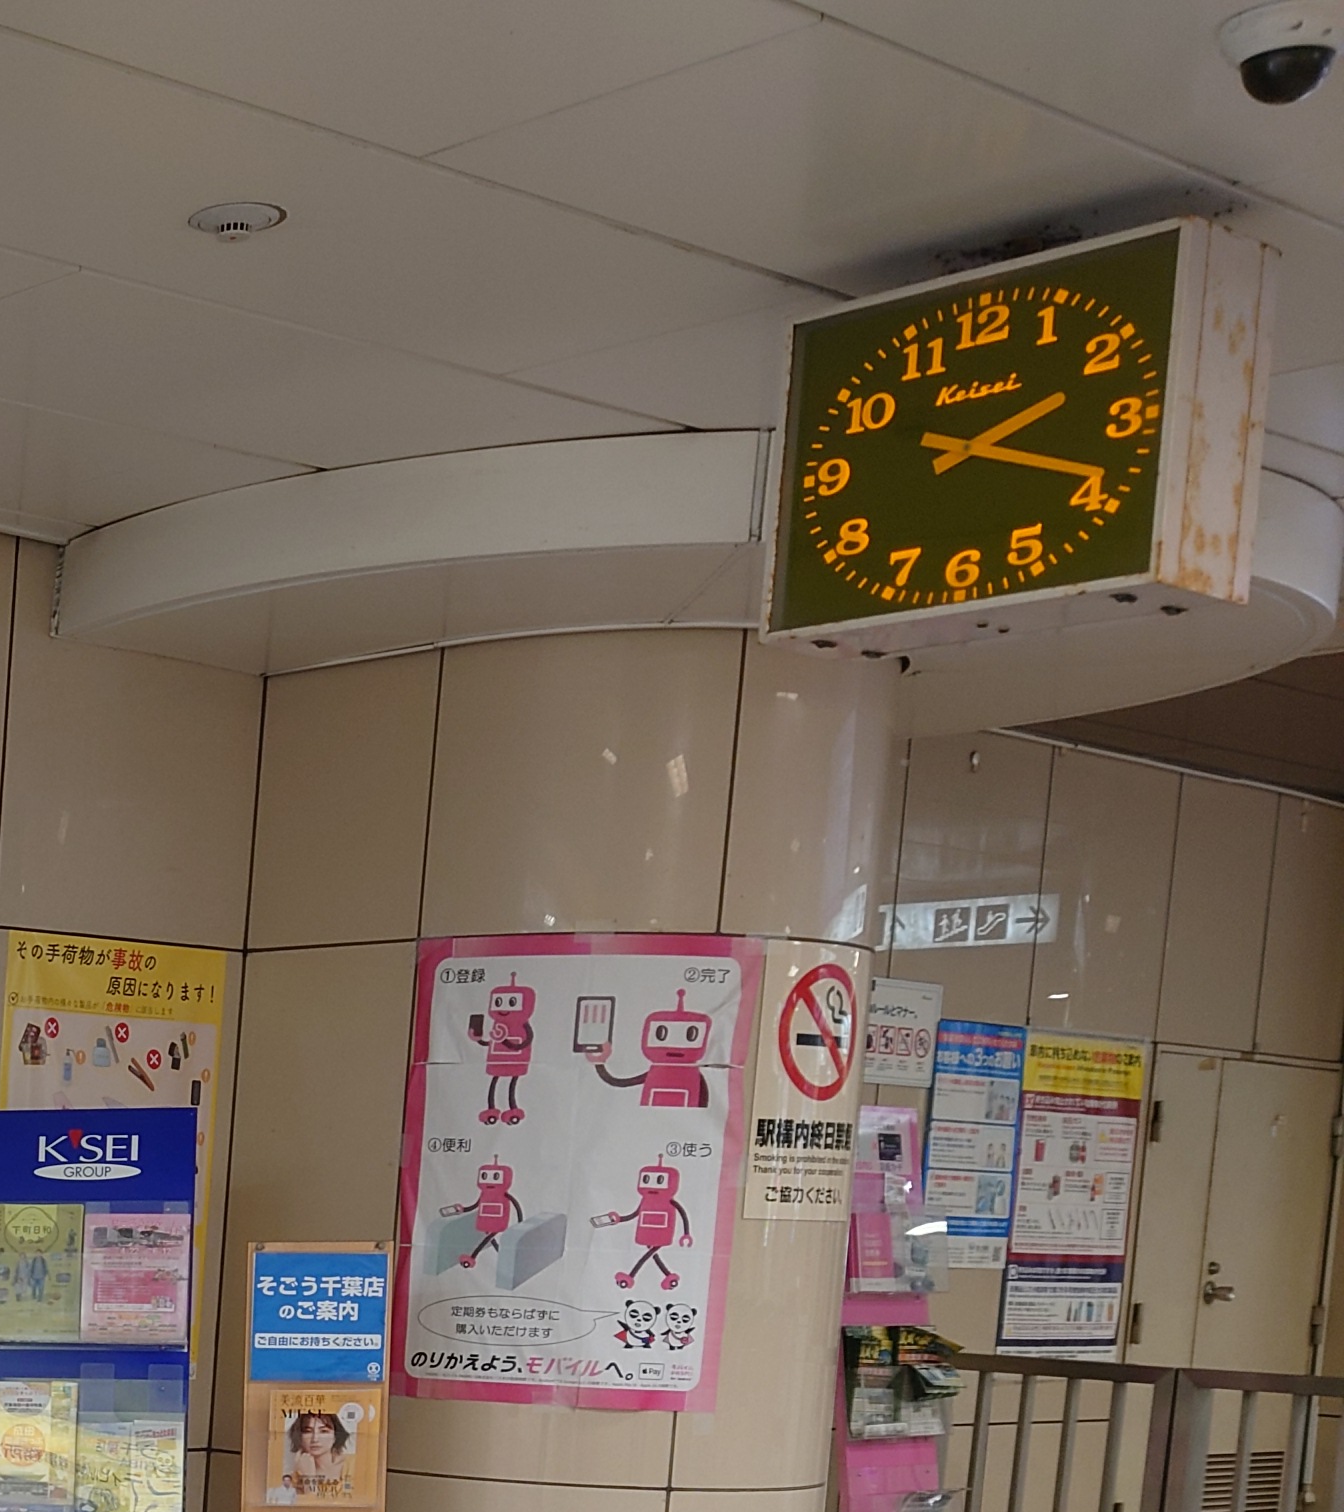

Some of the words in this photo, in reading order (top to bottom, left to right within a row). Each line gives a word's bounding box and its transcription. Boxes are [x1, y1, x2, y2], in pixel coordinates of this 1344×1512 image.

[955, 305, 1010, 350] 12
[1036, 306, 1058, 345] 1
[900, 338, 946, 382] 11
[1083, 333, 1121, 375] 2
[935, 372, 1022, 407] Keisei
[845, 392, 896, 435] 10
[1105, 397, 1143, 438] 3
[818, 459, 850, 496] 9
[1069, 474, 1108, 512] 4
[836, 518, 869, 556] 8
[1007, 524, 1043, 565] 5
[889, 547, 921, 586] 7
[945, 550, 981, 587] 6
[16, 941, 157, 971] その手荷物が事故の
[63, 1165, 112, 1178] GROUP
[753, 1165, 776, 1174] Thank
[779, 1167, 791, 1175] you
[754, 1153, 787, 1164] Smoking
[765, 1186, 843, 1205] ご協力ください
[257, 1276, 385, 1297] そごう千葉店
[279, 1300, 359, 1321] のご案内
[451, 1305, 560, 1321] 定期券もならばずに
[456, 1323, 553, 1339] 購入いただけます
